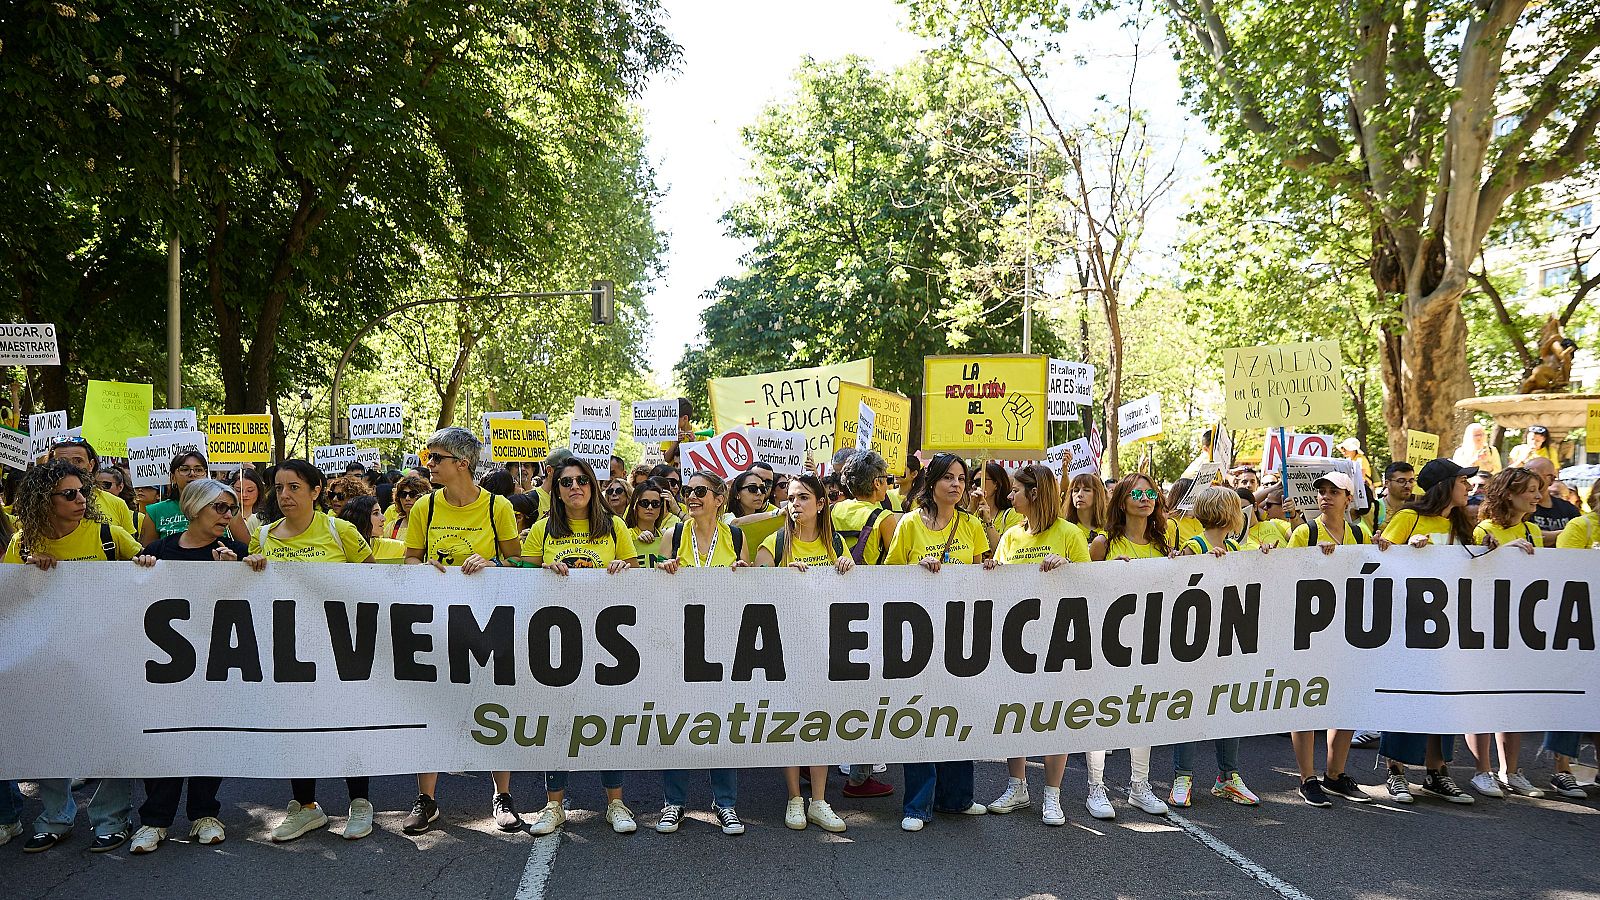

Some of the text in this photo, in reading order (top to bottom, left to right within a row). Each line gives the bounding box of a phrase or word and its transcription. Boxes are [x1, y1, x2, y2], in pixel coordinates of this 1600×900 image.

[45, 326, 54, 338] O
[1050, 363, 1057, 375] El
[1232, 345, 1333, 379] AZALEAS
[963, 362, 980, 381] LA
[761, 375, 841, 408] RATIO
[944, 376, 1007, 399] REVOLUCIÓN
[1063, 378, 1075, 394] ES
[1234, 388, 1247, 401] en
[1251, 381, 1262, 399] la
[351, 406, 401, 420] CALLAR ES
[968, 401, 985, 415] DEL
[1246, 400, 1264, 421] del
[48, 413, 62, 430] NOS
[209, 422, 241, 435] MENTES
[352, 422, 402, 437] COMPLICIDAD
[964, 419, 994, 436] 0-3
[492, 428, 521, 441] MENTES
[580, 429, 611, 441] ESCUELAS
[209, 441, 247, 454] SOCIEDAD
[572, 441, 610, 456] PÚBLICAS
[756, 435, 785, 452] Instruir,
[315, 446, 357, 460] CALLAR ES
[493, 445, 548, 459] SOCIEDAD LIBRE
[688, 431, 754, 480] NO
[136, 462, 159, 479] AYUSO,
[1294, 495, 1316, 507] PARA
[143, 564, 1596, 688] SALVEMOS LA EDUCACIÓN PÚBLICA
[471, 668, 1330, 759] Su privatización, nuestra ruina
